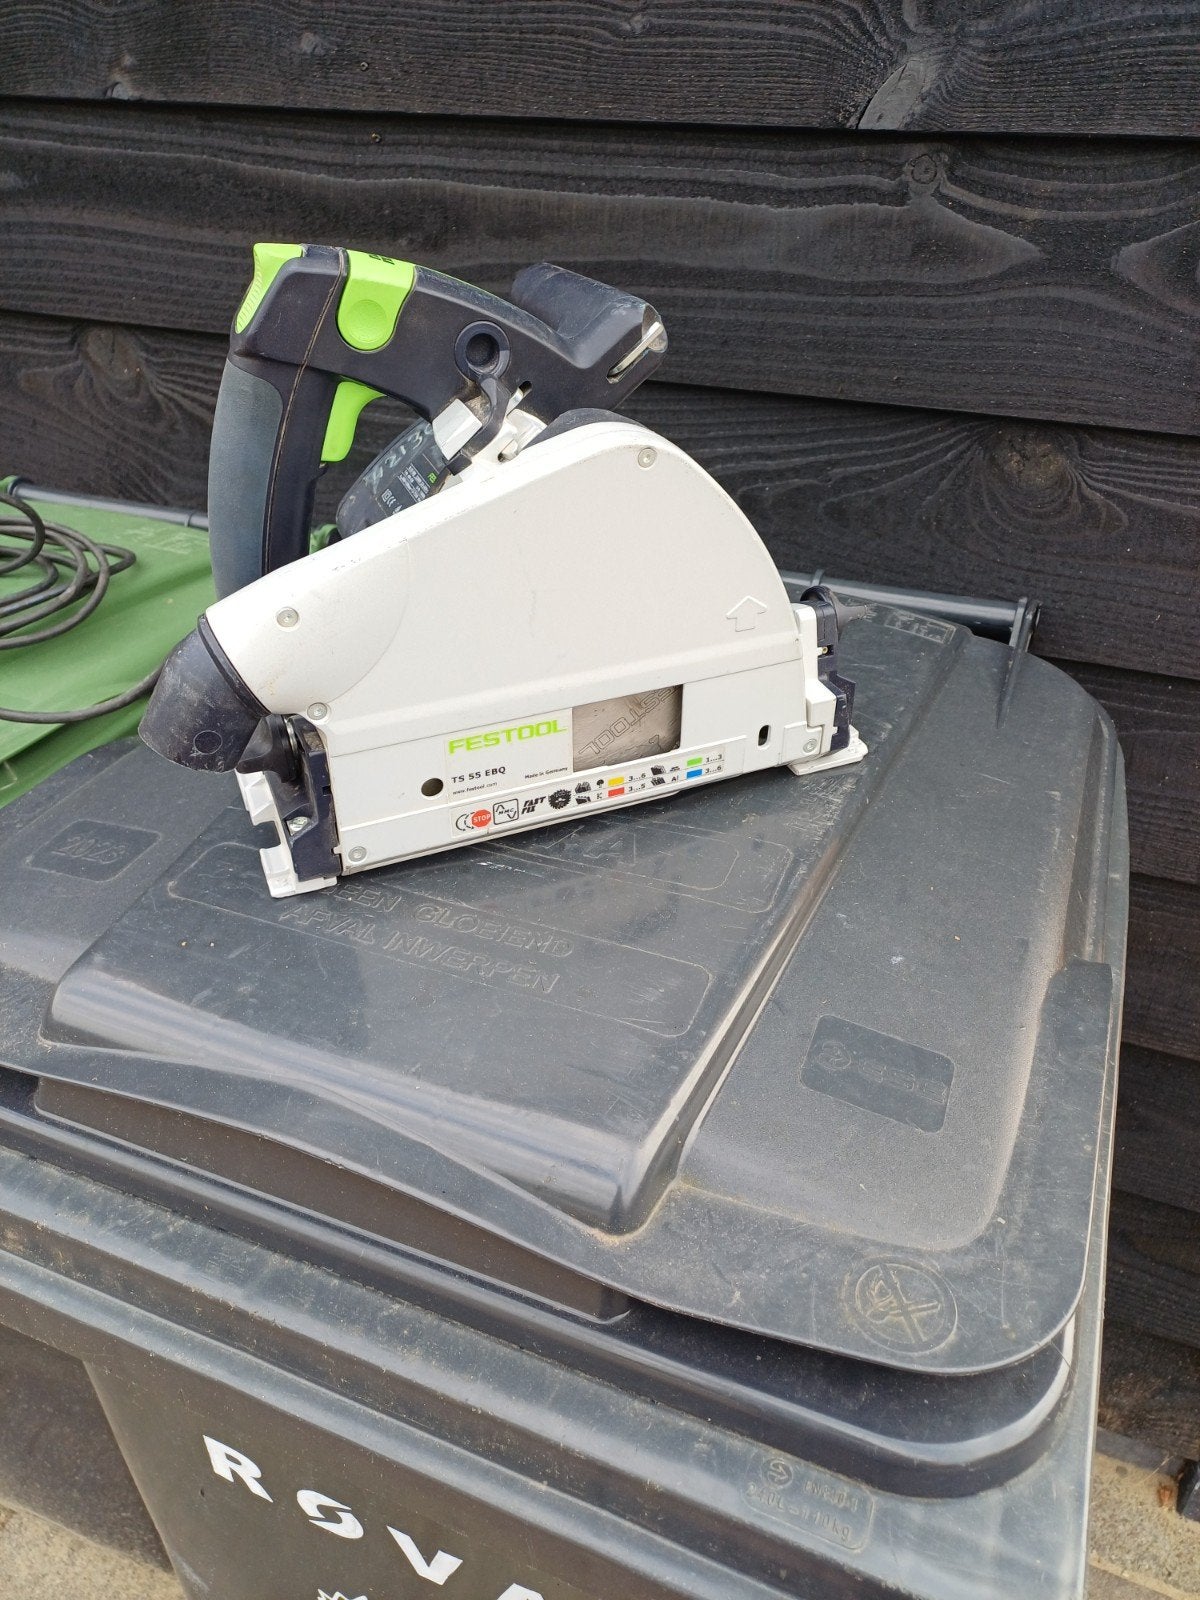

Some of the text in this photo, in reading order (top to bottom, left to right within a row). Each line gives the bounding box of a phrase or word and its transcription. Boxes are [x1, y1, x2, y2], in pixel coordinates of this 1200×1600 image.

[449, 719, 568, 755] FESTOOL
[451, 766, 506, 784] TS 55 EBQ
[545, 766, 568, 775] Germany
[453, 782, 498, 795] www.festool.com
[523, 796, 546, 808] FAST
[521, 806, 536, 815] FIX
[473, 813, 491, 823] STOP
